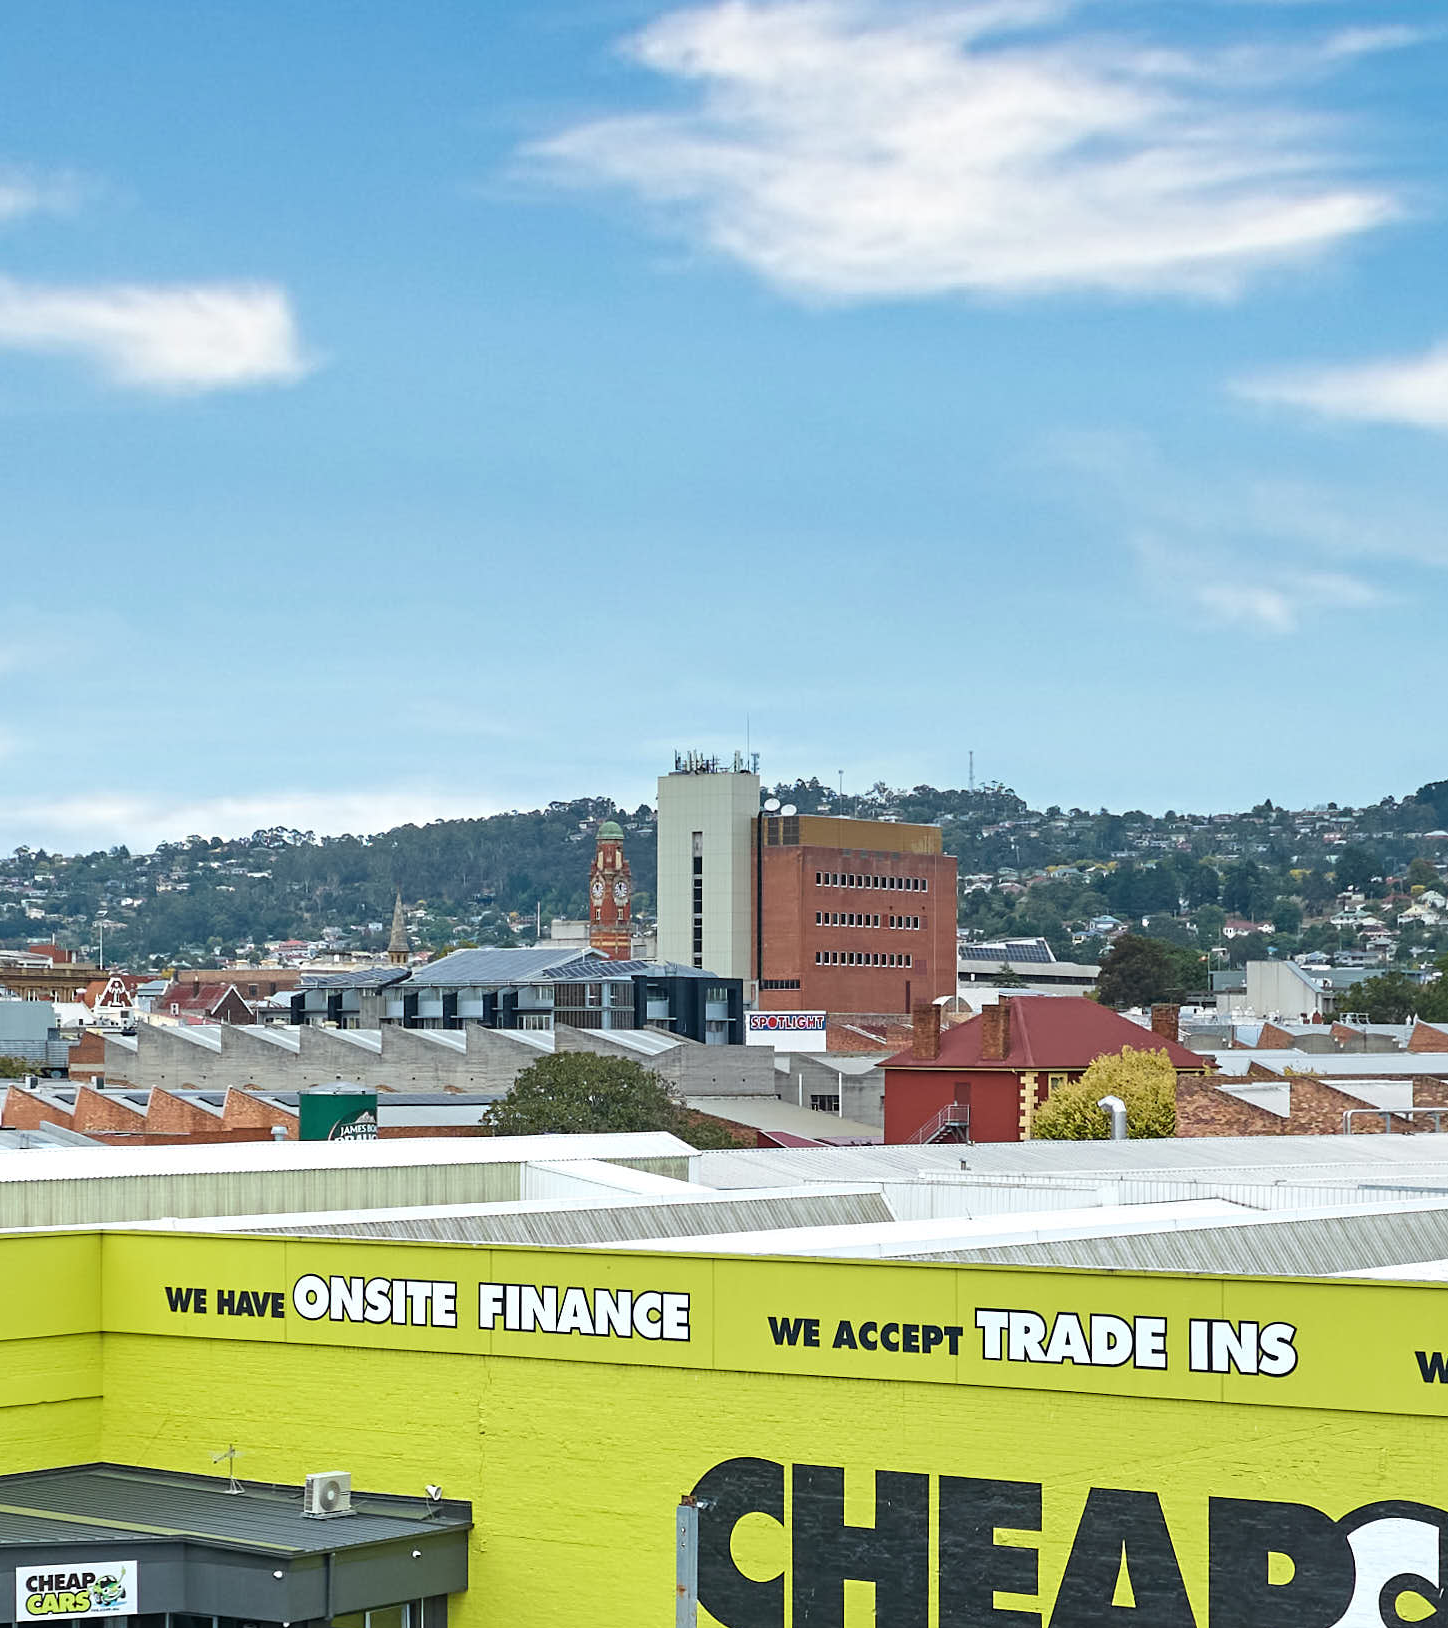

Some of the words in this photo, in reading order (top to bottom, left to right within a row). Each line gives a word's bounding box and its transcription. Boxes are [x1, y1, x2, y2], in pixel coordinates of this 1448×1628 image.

[750, 1015, 824, 1030] SPOTLIGHT
[166, 1286, 206, 1314] WE
[217, 1289, 285, 1318] HAVE
[292, 1274, 457, 1328] ONSITE
[479, 1282, 690, 1341] FINANCE
[768, 1316, 820, 1348] WE
[832, 1319, 963, 1355] ACCEPT
[974, 1307, 1167, 1369] TRADE
[1188, 1318, 1298, 1377] INS
[25, 1572, 96, 1592] CHEAP
[25, 1590, 92, 1615] CARS
